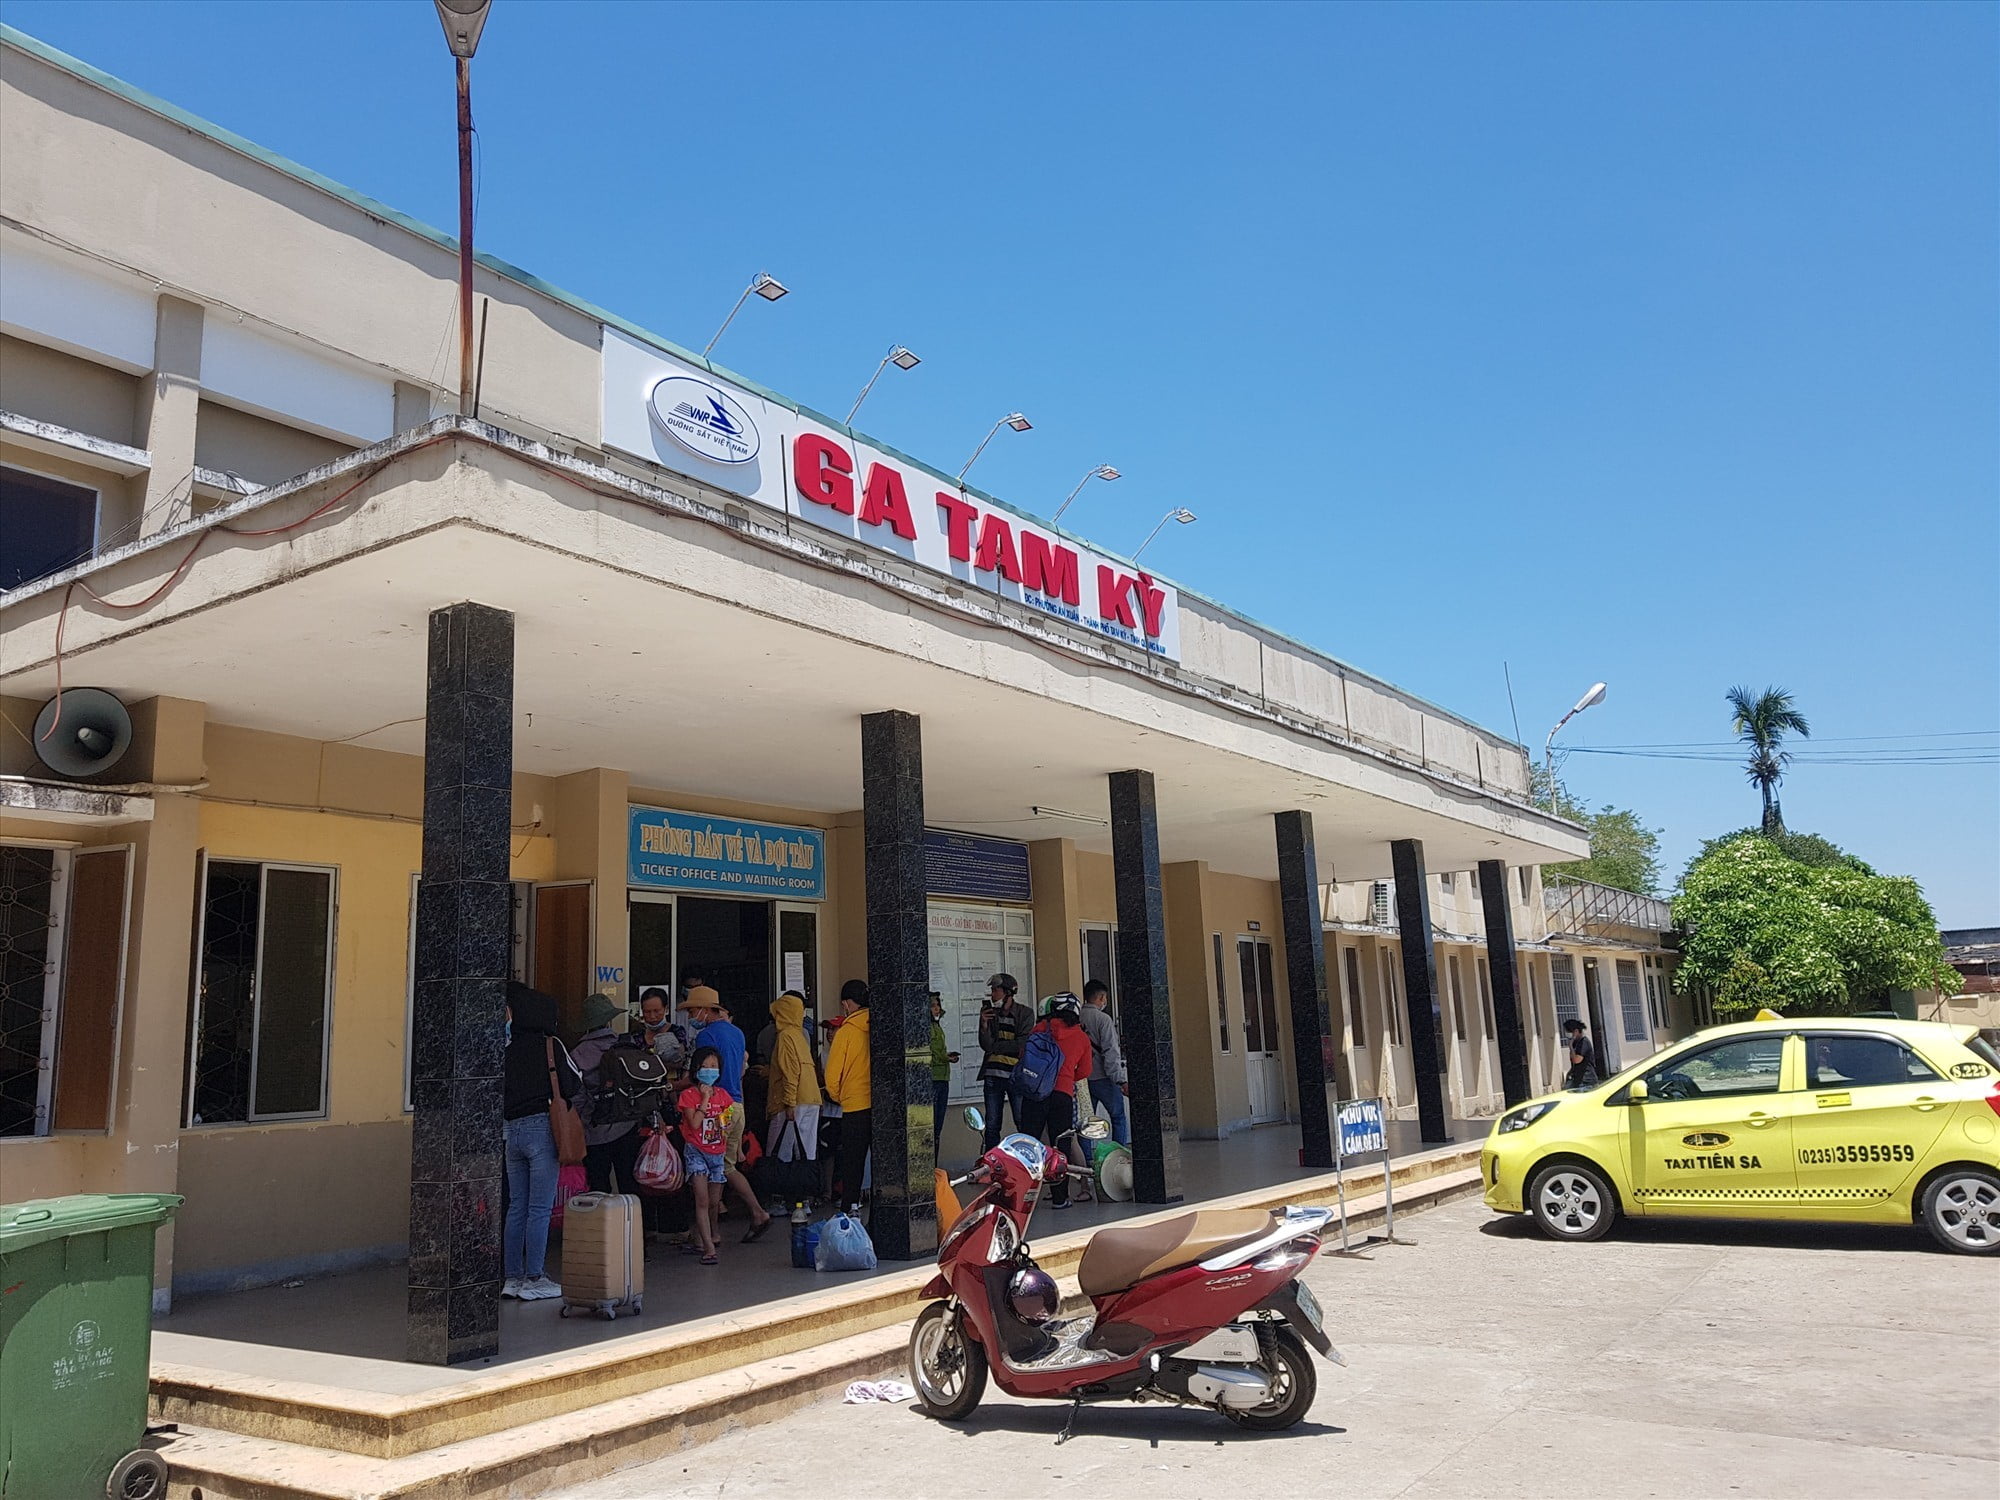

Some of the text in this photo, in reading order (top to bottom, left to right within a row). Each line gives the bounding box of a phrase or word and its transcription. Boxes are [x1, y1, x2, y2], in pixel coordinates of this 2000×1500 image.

[690, 406, 711, 424] VNR
[731, 443, 749, 456] NAM
[793, 433, 1166, 638] GA TAM KỲ
[640, 818, 814, 873] PHÒNG BÁN VÉ VÀ ĐỢI TÀU
[640, 863, 815, 889] TICKET OFFICE AND WAITING ROOM
[597, 966, 624, 983] WC
[1952, 1064, 1987, 1078] S.223
[1343, 1106, 1362, 1125] KHU
[1664, 1152, 1762, 1169] TAXI TIÊN SA
